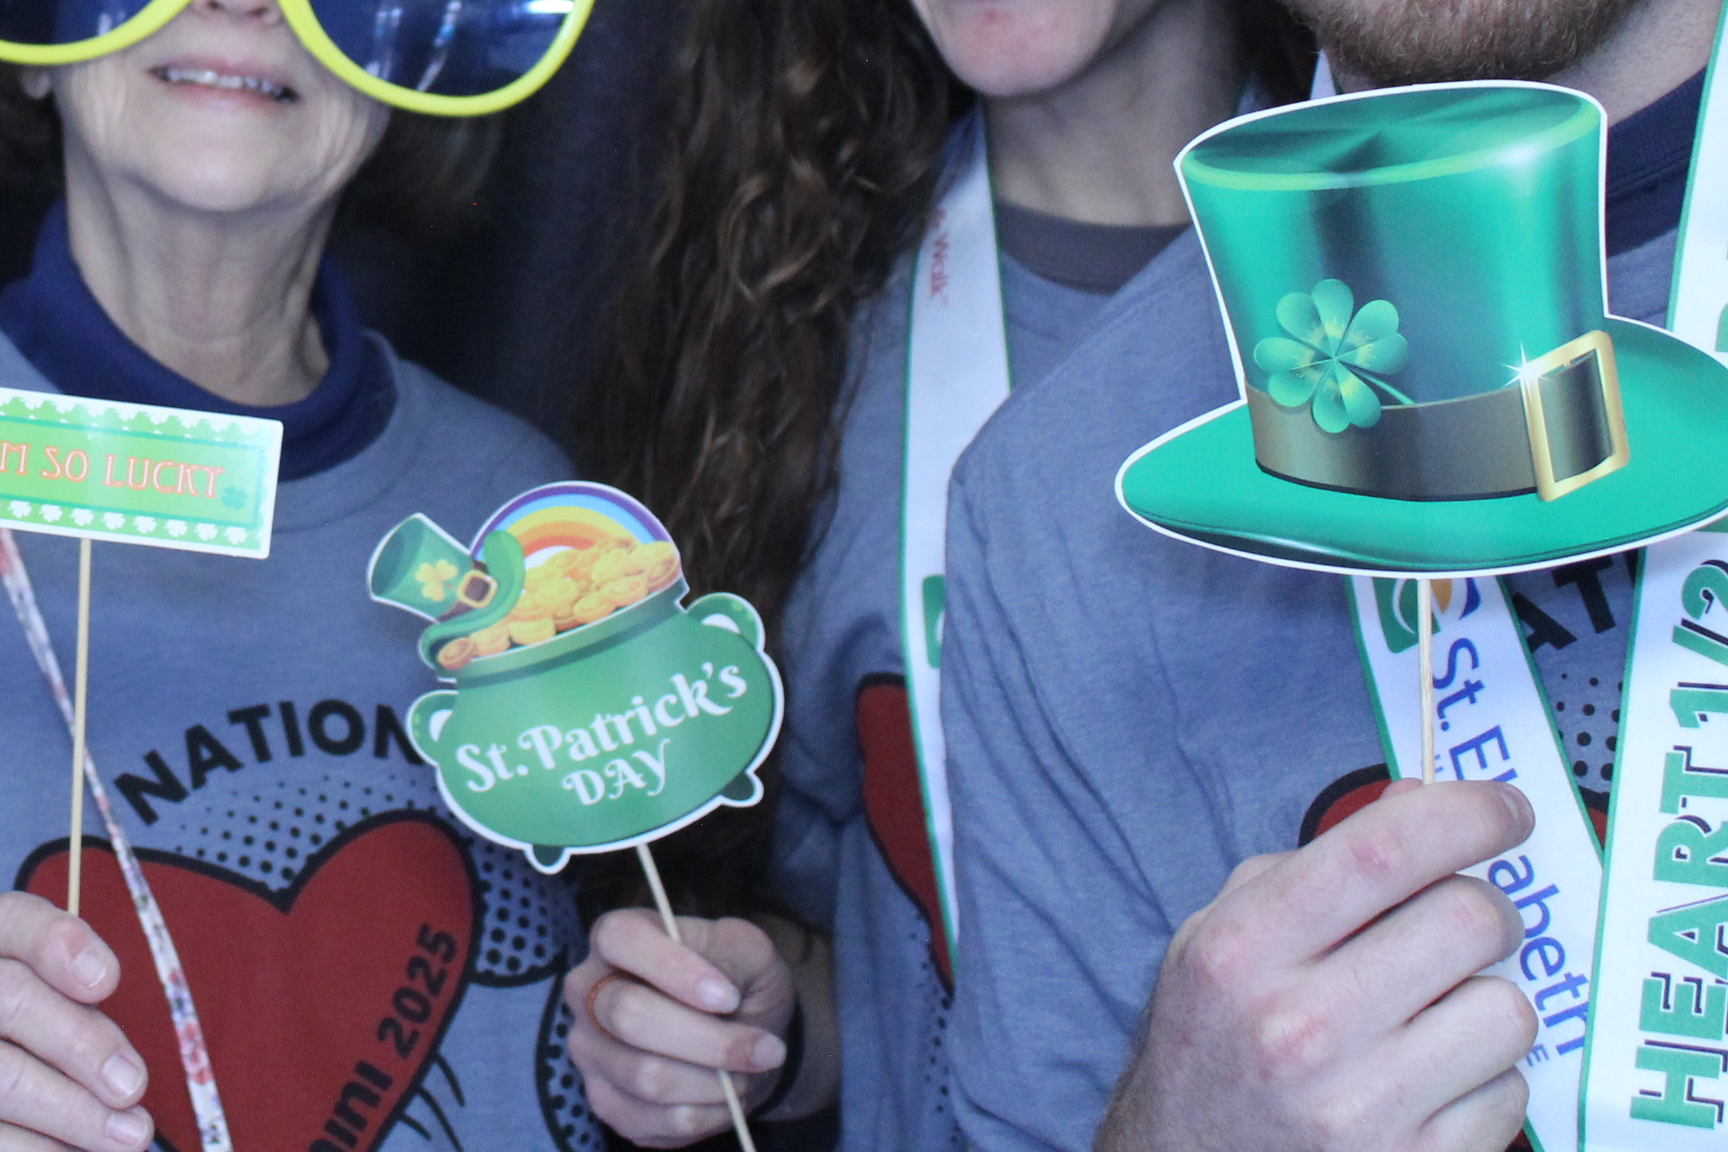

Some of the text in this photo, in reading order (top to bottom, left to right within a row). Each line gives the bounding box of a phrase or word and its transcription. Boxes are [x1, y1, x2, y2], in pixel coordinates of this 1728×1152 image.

[40, 446, 88, 483] SO
[102, 454, 225, 498] LUCKY
[455, 661, 748, 792] St. Patrick's
[1432, 637, 1486, 732] St.
[561, 739, 672, 806] DAY
[376, 924, 457, 1059] 2025
[1629, 745, 1728, 1131] HEART
